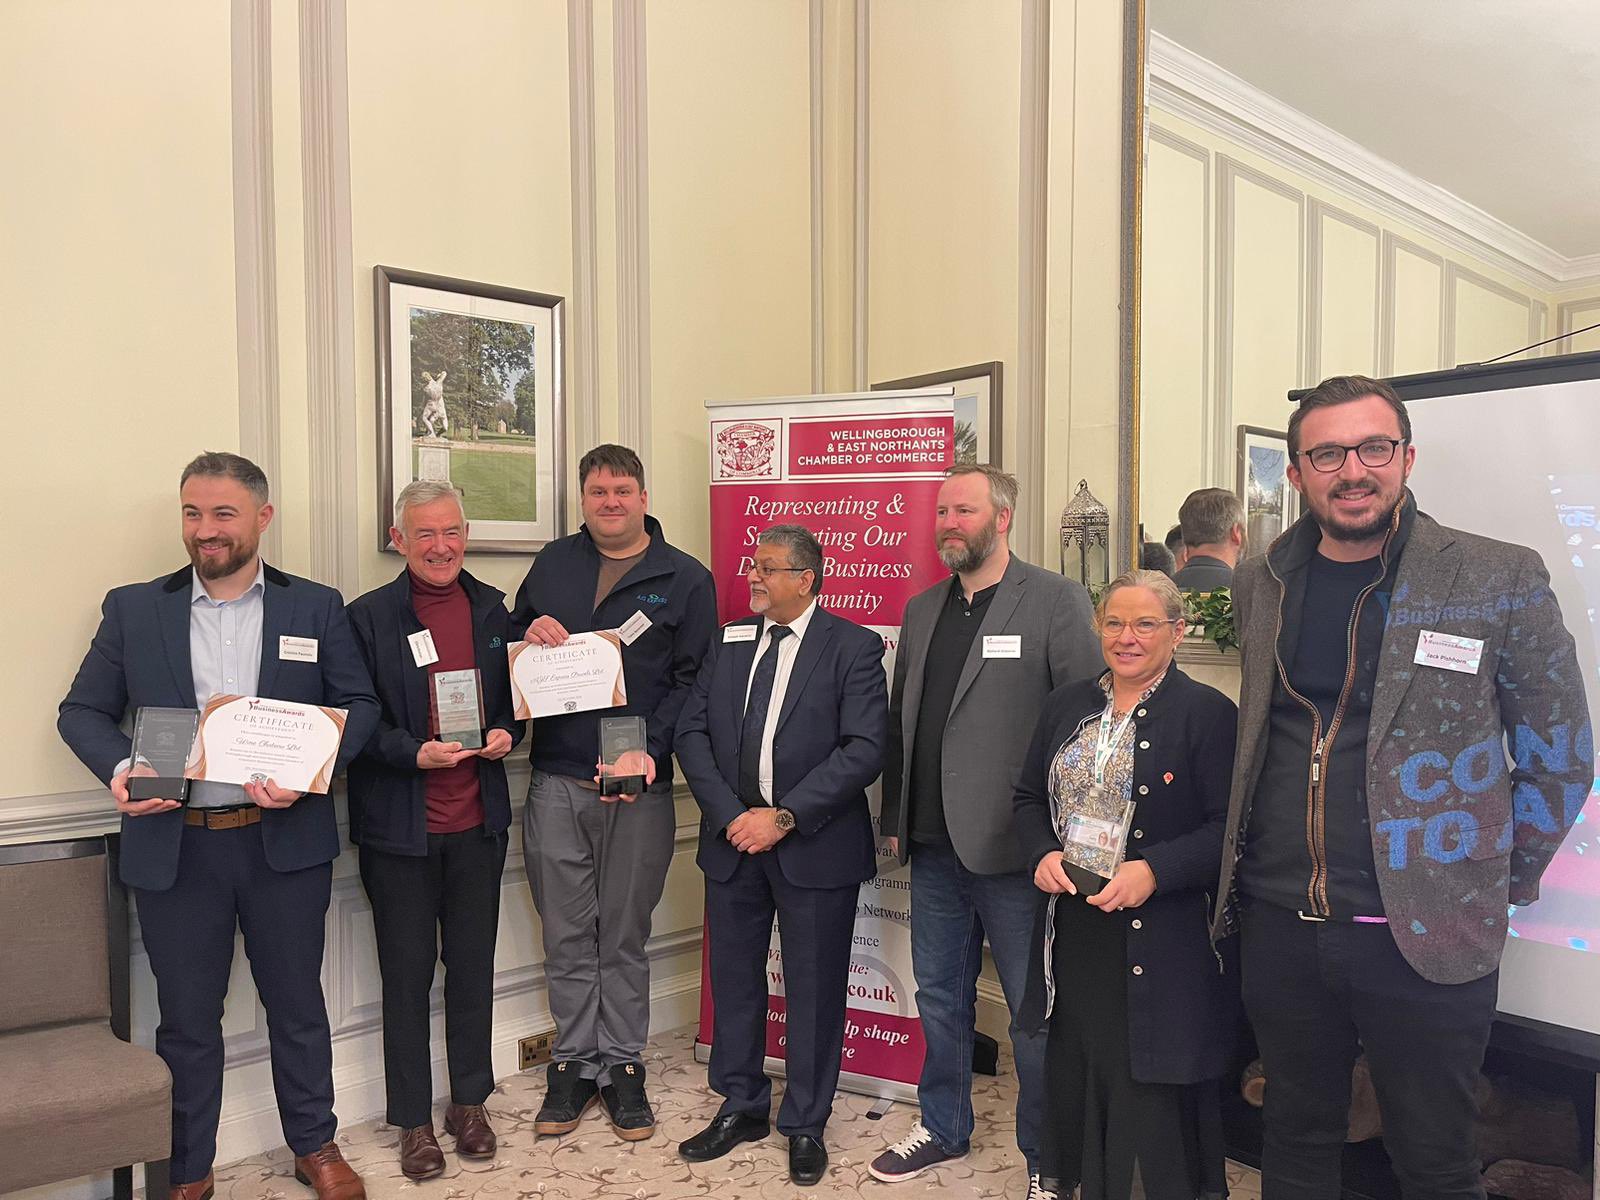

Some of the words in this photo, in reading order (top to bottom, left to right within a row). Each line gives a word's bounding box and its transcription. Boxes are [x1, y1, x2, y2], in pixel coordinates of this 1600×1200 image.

[830, 427, 945, 440] WELLINGBOROUGH
[827, 444, 835, 452] &
[838, 442, 867, 452] EAST
[870, 440, 945, 451] NORTHANTS
[797, 455, 852, 466] CHAMBER
[856, 454, 873, 464] OF
[876, 452, 945, 463] COMMERCE
[744, 495, 879, 521] Representing
[886, 493, 905, 515] &
[863, 525, 907, 547] Our
[823, 556, 912, 579] Business
[815, 589, 883, 615] munity
[532, 648, 598, 663] CERTIFICATE
[253, 705, 305, 717] BusinessAwards
[234, 713, 313, 731] CERTIFICATE
[1376, 810, 1480, 871] TO
[863, 1024, 910, 1046] shape
